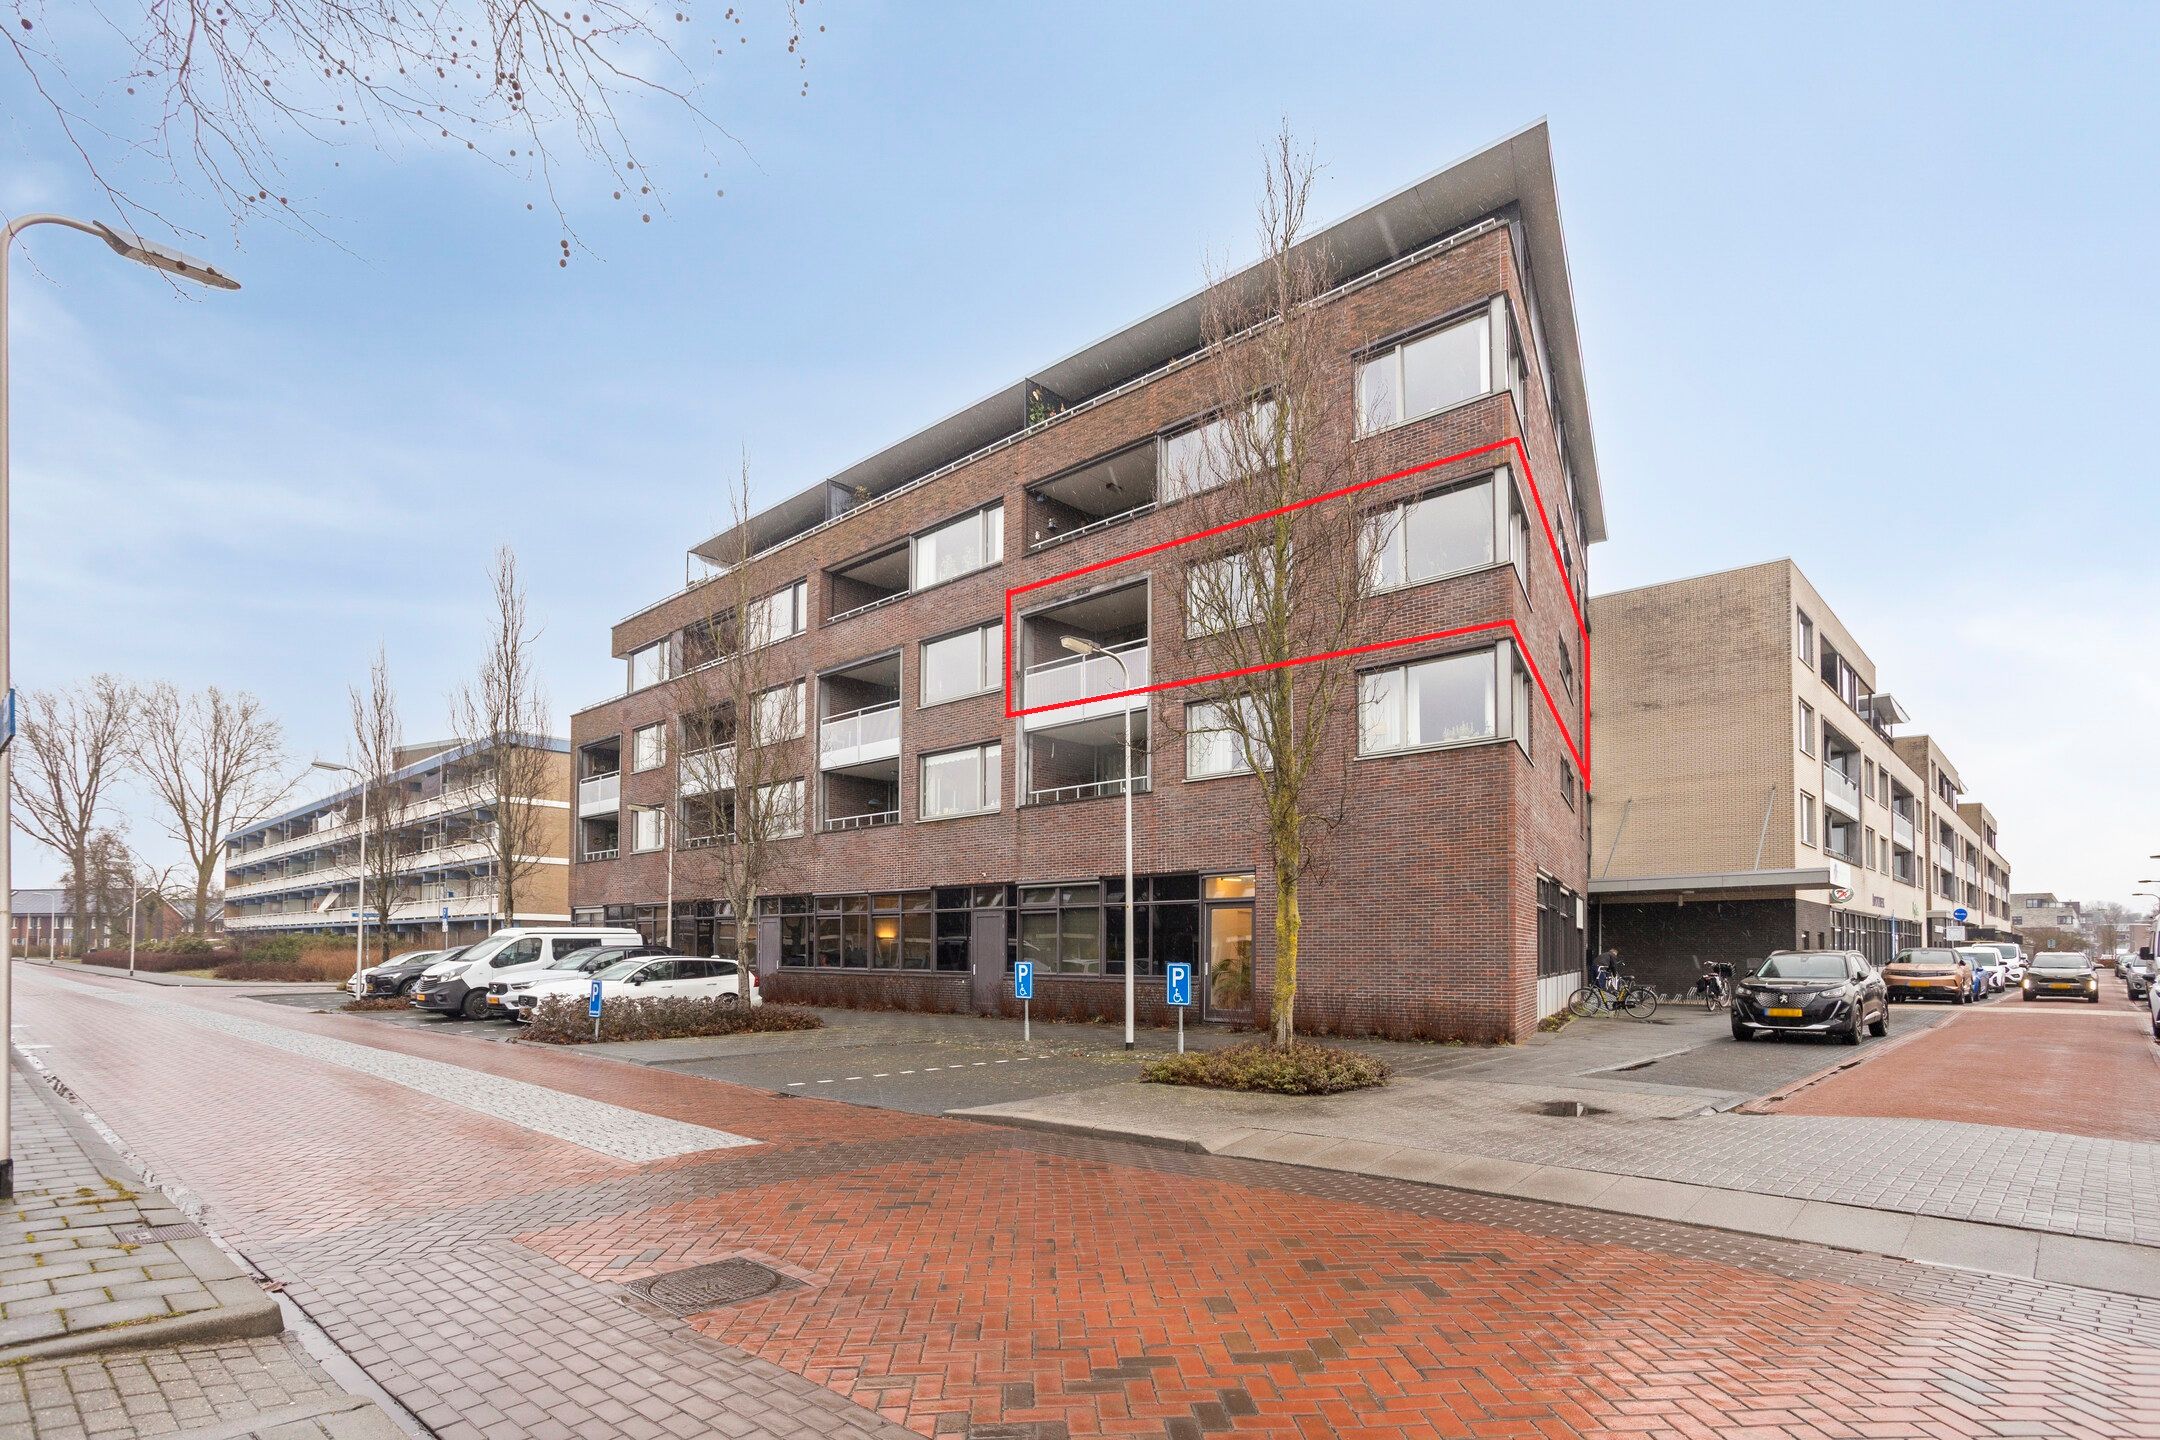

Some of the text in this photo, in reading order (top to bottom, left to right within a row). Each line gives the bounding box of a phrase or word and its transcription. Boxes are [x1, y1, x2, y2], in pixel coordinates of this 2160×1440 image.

[1018, 965, 1029, 983] P
[1172, 967, 1185, 988] P
[592, 983, 599, 1002] P
